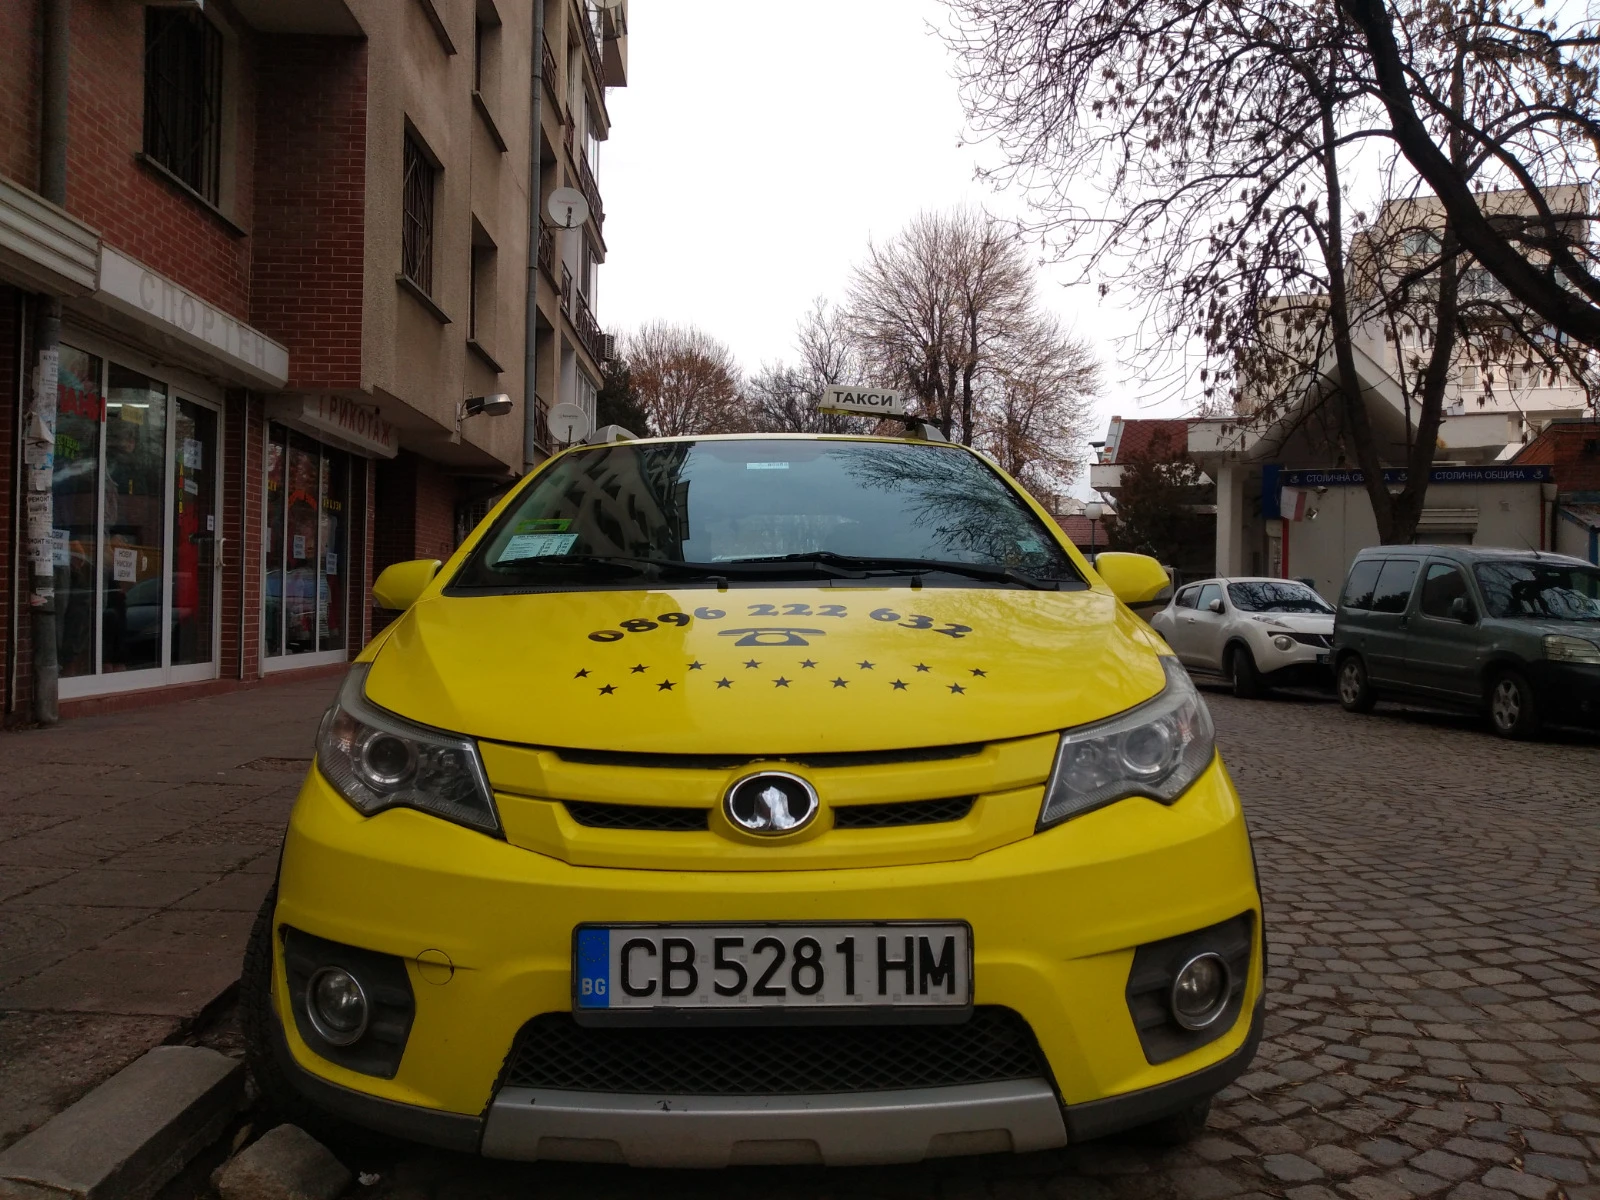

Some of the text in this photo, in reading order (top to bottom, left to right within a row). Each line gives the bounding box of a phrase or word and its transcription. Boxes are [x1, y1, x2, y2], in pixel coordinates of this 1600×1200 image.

[139, 271, 266, 370] СПОРТЕН
[833, 391, 893, 407] ТАКСИ
[1306, 472, 1352, 483] СТОЛИЧНА
[1435, 469, 1525, 480] СТОЛИЧНА ОБЩИНА
[588, 603, 973, 643] 0896 222 632
[620, 935, 956, 996] CB 5281 HM
[581, 978, 606, 995] BG
